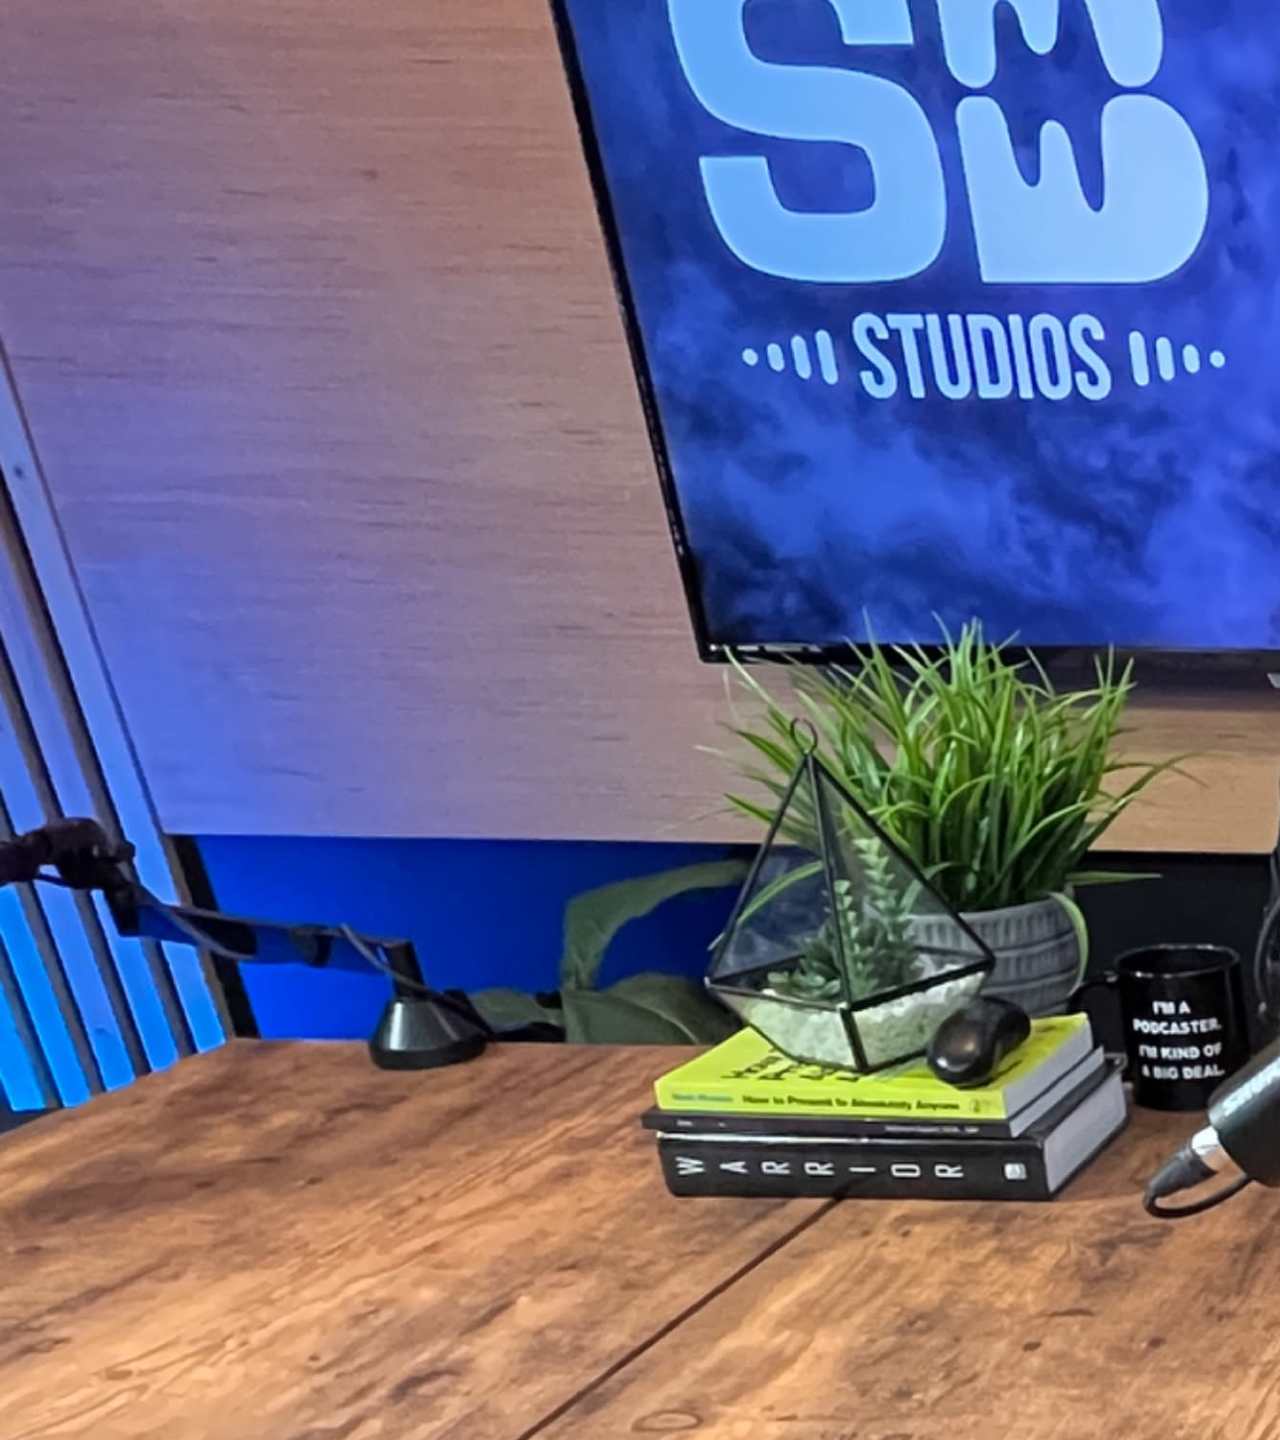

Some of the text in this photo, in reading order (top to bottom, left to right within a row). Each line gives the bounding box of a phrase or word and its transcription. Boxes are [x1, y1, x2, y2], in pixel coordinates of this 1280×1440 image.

[852, 312, 1112, 400] STUDIOS
[1179, 1000, 1191, 1014] A
[1203, 1043, 1222, 1057] OF
[676, 1156, 965, 1178] WARRIOR
